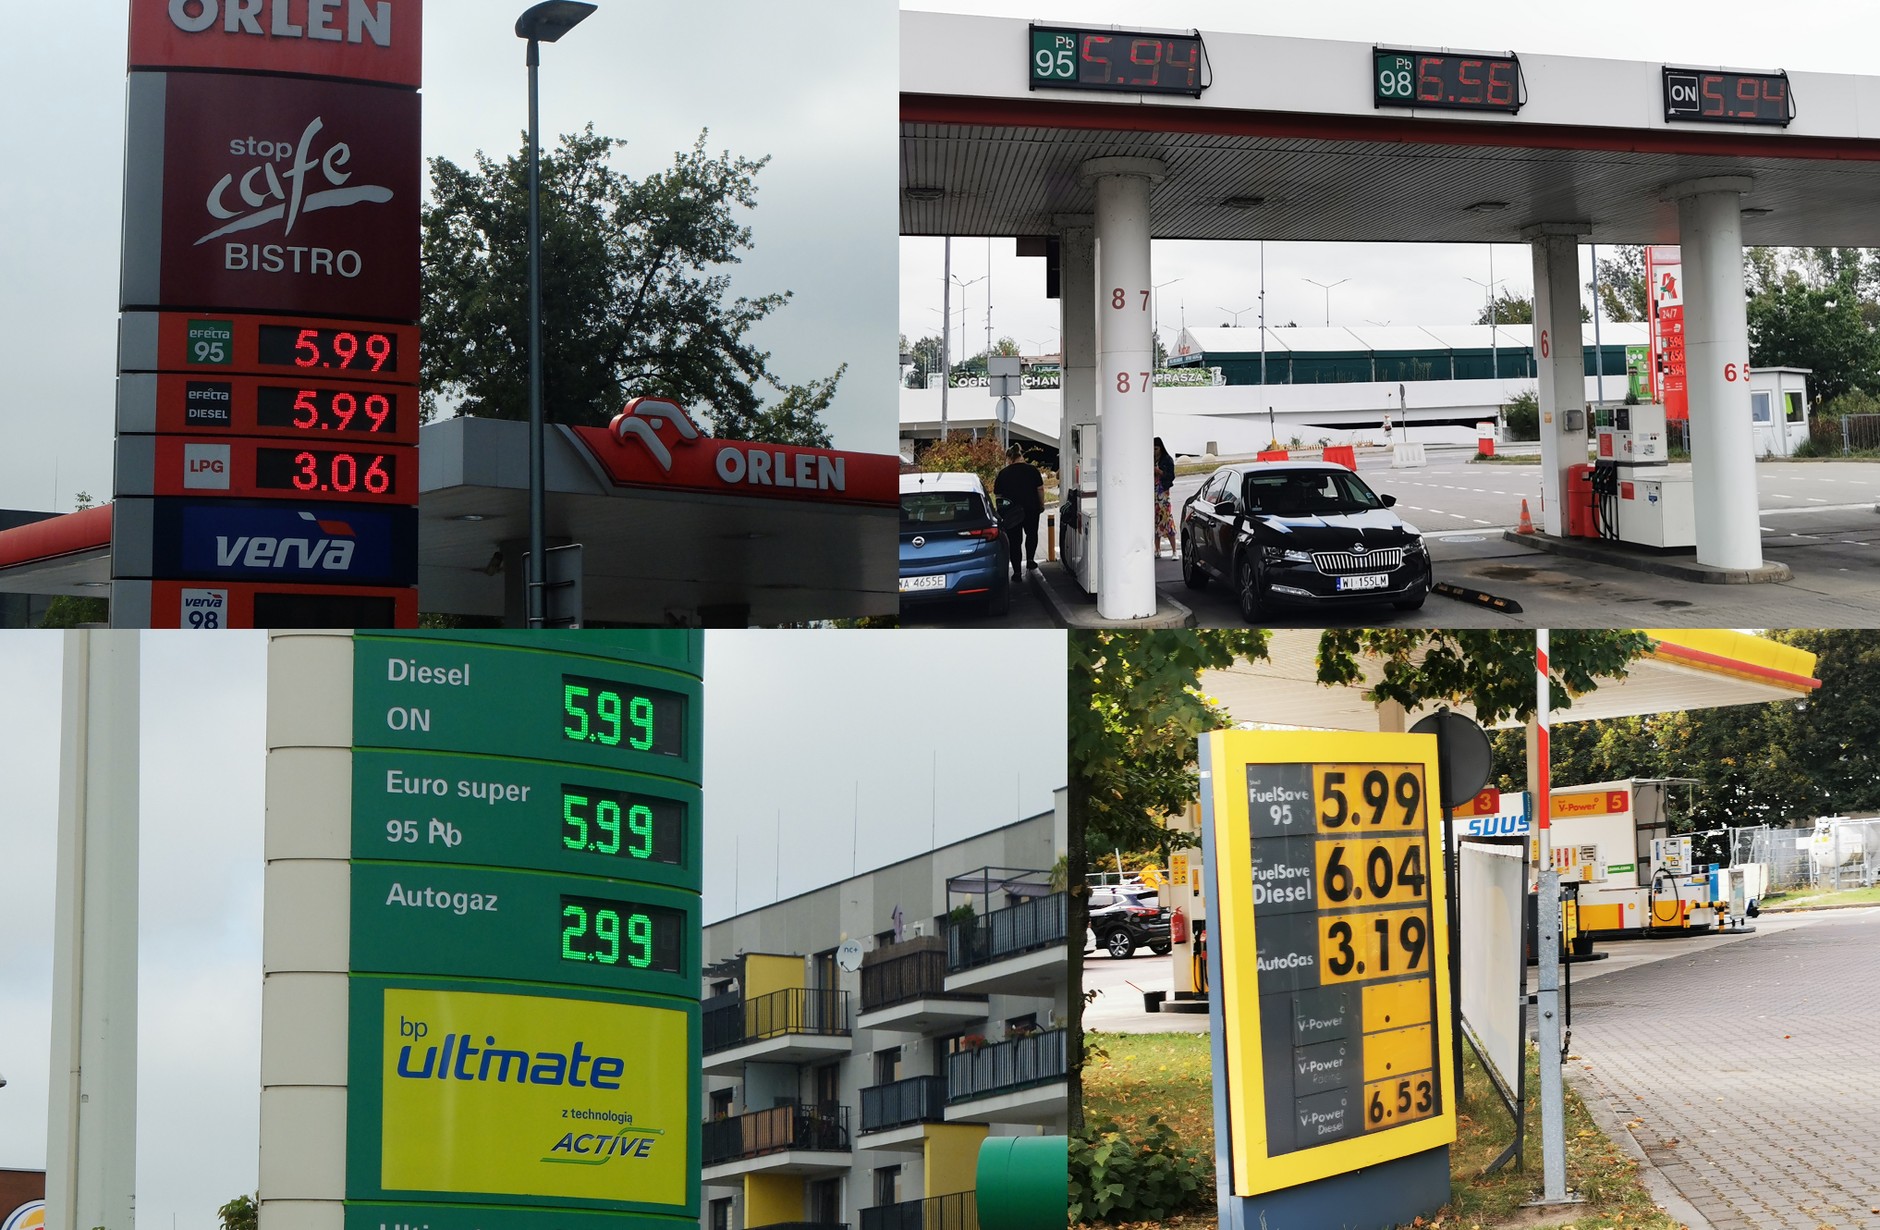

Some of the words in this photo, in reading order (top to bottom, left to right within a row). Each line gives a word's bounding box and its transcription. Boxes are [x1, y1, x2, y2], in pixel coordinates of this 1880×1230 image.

[168, 0, 391, 47] ORLEN
[1055, 36, 1075, 50] Pb
[1035, 49, 1075, 77] 95
[1082, 35, 1198, 86] 5.94
[1396, 57, 1412, 71] Pb
[1380, 71, 1412, 97] 98
[1417, 57, 1514, 104] 6.56
[1671, 84, 1697, 102] ON
[1702, 76, 1786, 119] 5.94
[230, 136, 293, 162] stop
[225, 243, 362, 278] BISTRO
[1112, 288, 1126, 309] 8
[1139, 290, 1150, 311] 7
[1662, 308, 1678, 319] 24/7
[189, 326, 230, 339] efecta
[1541, 329, 1549, 358] 6
[194, 341, 225, 363] 95
[294, 329, 391, 372] 5.99
[958, 377, 991, 388] OGR
[1152, 373, 1204, 383] PRASZA
[1116, 372, 1130, 393] 8
[1139, 372, 1150, 392] 7
[1724, 363, 1737, 382] 6
[188, 387, 229, 401] efecta
[188, 409, 228, 420] DIESEL
[293, 390, 390, 432] 5.99
[190, 459, 224, 473] LPG
[292, 451, 389, 494] 3.06
[716, 447, 846, 492] ORLEN
[216, 535, 356, 570] verva
[913, 575, 944, 587] 4655E
[1342, 578, 1353, 588] WI
[1359, 576, 1386, 587] 155LM
[185, 597, 223, 608] verva
[188, 610, 218, 629] 98
[387, 658, 470, 687] Diesel
[387, 706, 430, 732] ON
[564, 684, 653, 751] 5.99
[387, 770, 448, 796] Euro
[457, 777, 530, 805] super
[1249, 786, 1309, 803] FuelSave
[1322, 770, 1421, 829] 5.99
[1480, 793, 1492, 811] 3
[1558, 803, 1597, 812] V-Power
[1611, 794, 1622, 809] 5
[1270, 804, 1293, 825] 95
[1469, 815, 1529, 836] SUUS
[386, 820, 419, 844] 95
[563, 794, 652, 860] 5.99
[1251, 863, 1310, 880] FuelSave
[1323, 845, 1425, 903] 6.04
[386, 882, 498, 915] Autogaz
[1252, 878, 1312, 905] Diesel
[562, 905, 652, 969] 2.99
[1328, 915, 1426, 976] 3.19
[1257, 952, 1314, 971] AutoGas
[400, 1015, 428, 1042] bp
[1298, 1017, 1342, 1031] V-Power
[396, 1033, 625, 1090] ultimate
[1299, 1059, 1343, 1074] V-Power
[1370, 1080, 1432, 1123] 6.53
[561, 1109, 568, 1118] z
[571, 1108, 634, 1127] technologią
[1300, 1109, 1344, 1126] V-Power
[1318, 1117, 1343, 1135] Diesel
[551, 1132, 656, 1159] ACTIVE
